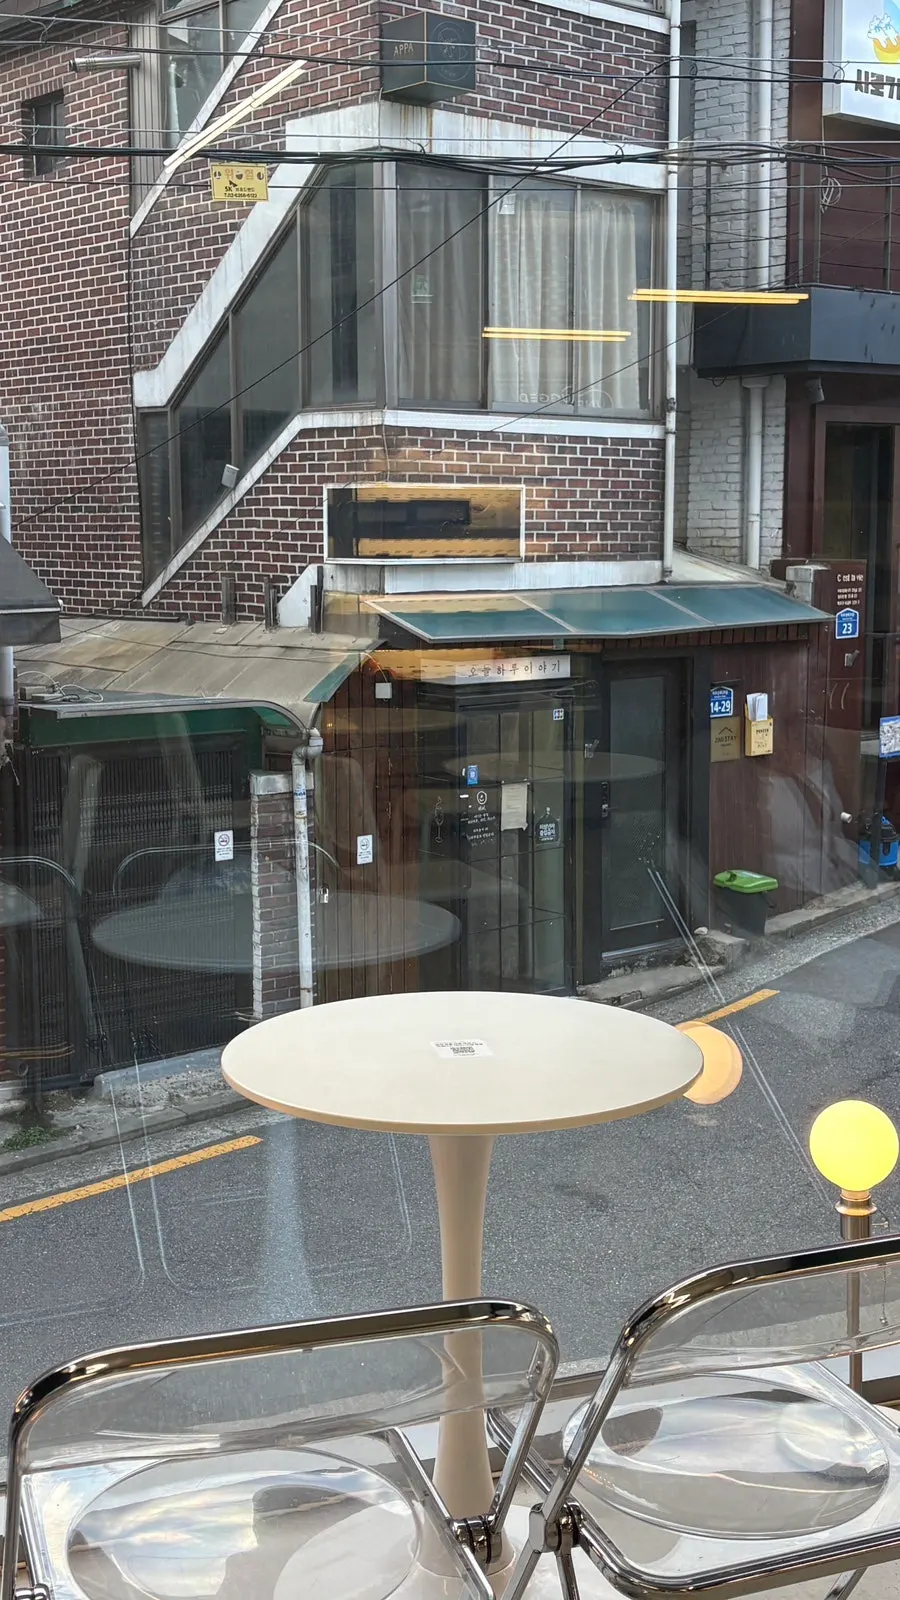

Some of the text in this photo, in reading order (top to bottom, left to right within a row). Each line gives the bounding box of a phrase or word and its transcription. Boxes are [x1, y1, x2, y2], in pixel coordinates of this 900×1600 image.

[393, 42, 414, 57] APPA
[842, 622, 853, 634] 23
[710, 700, 731, 713] 14-29
